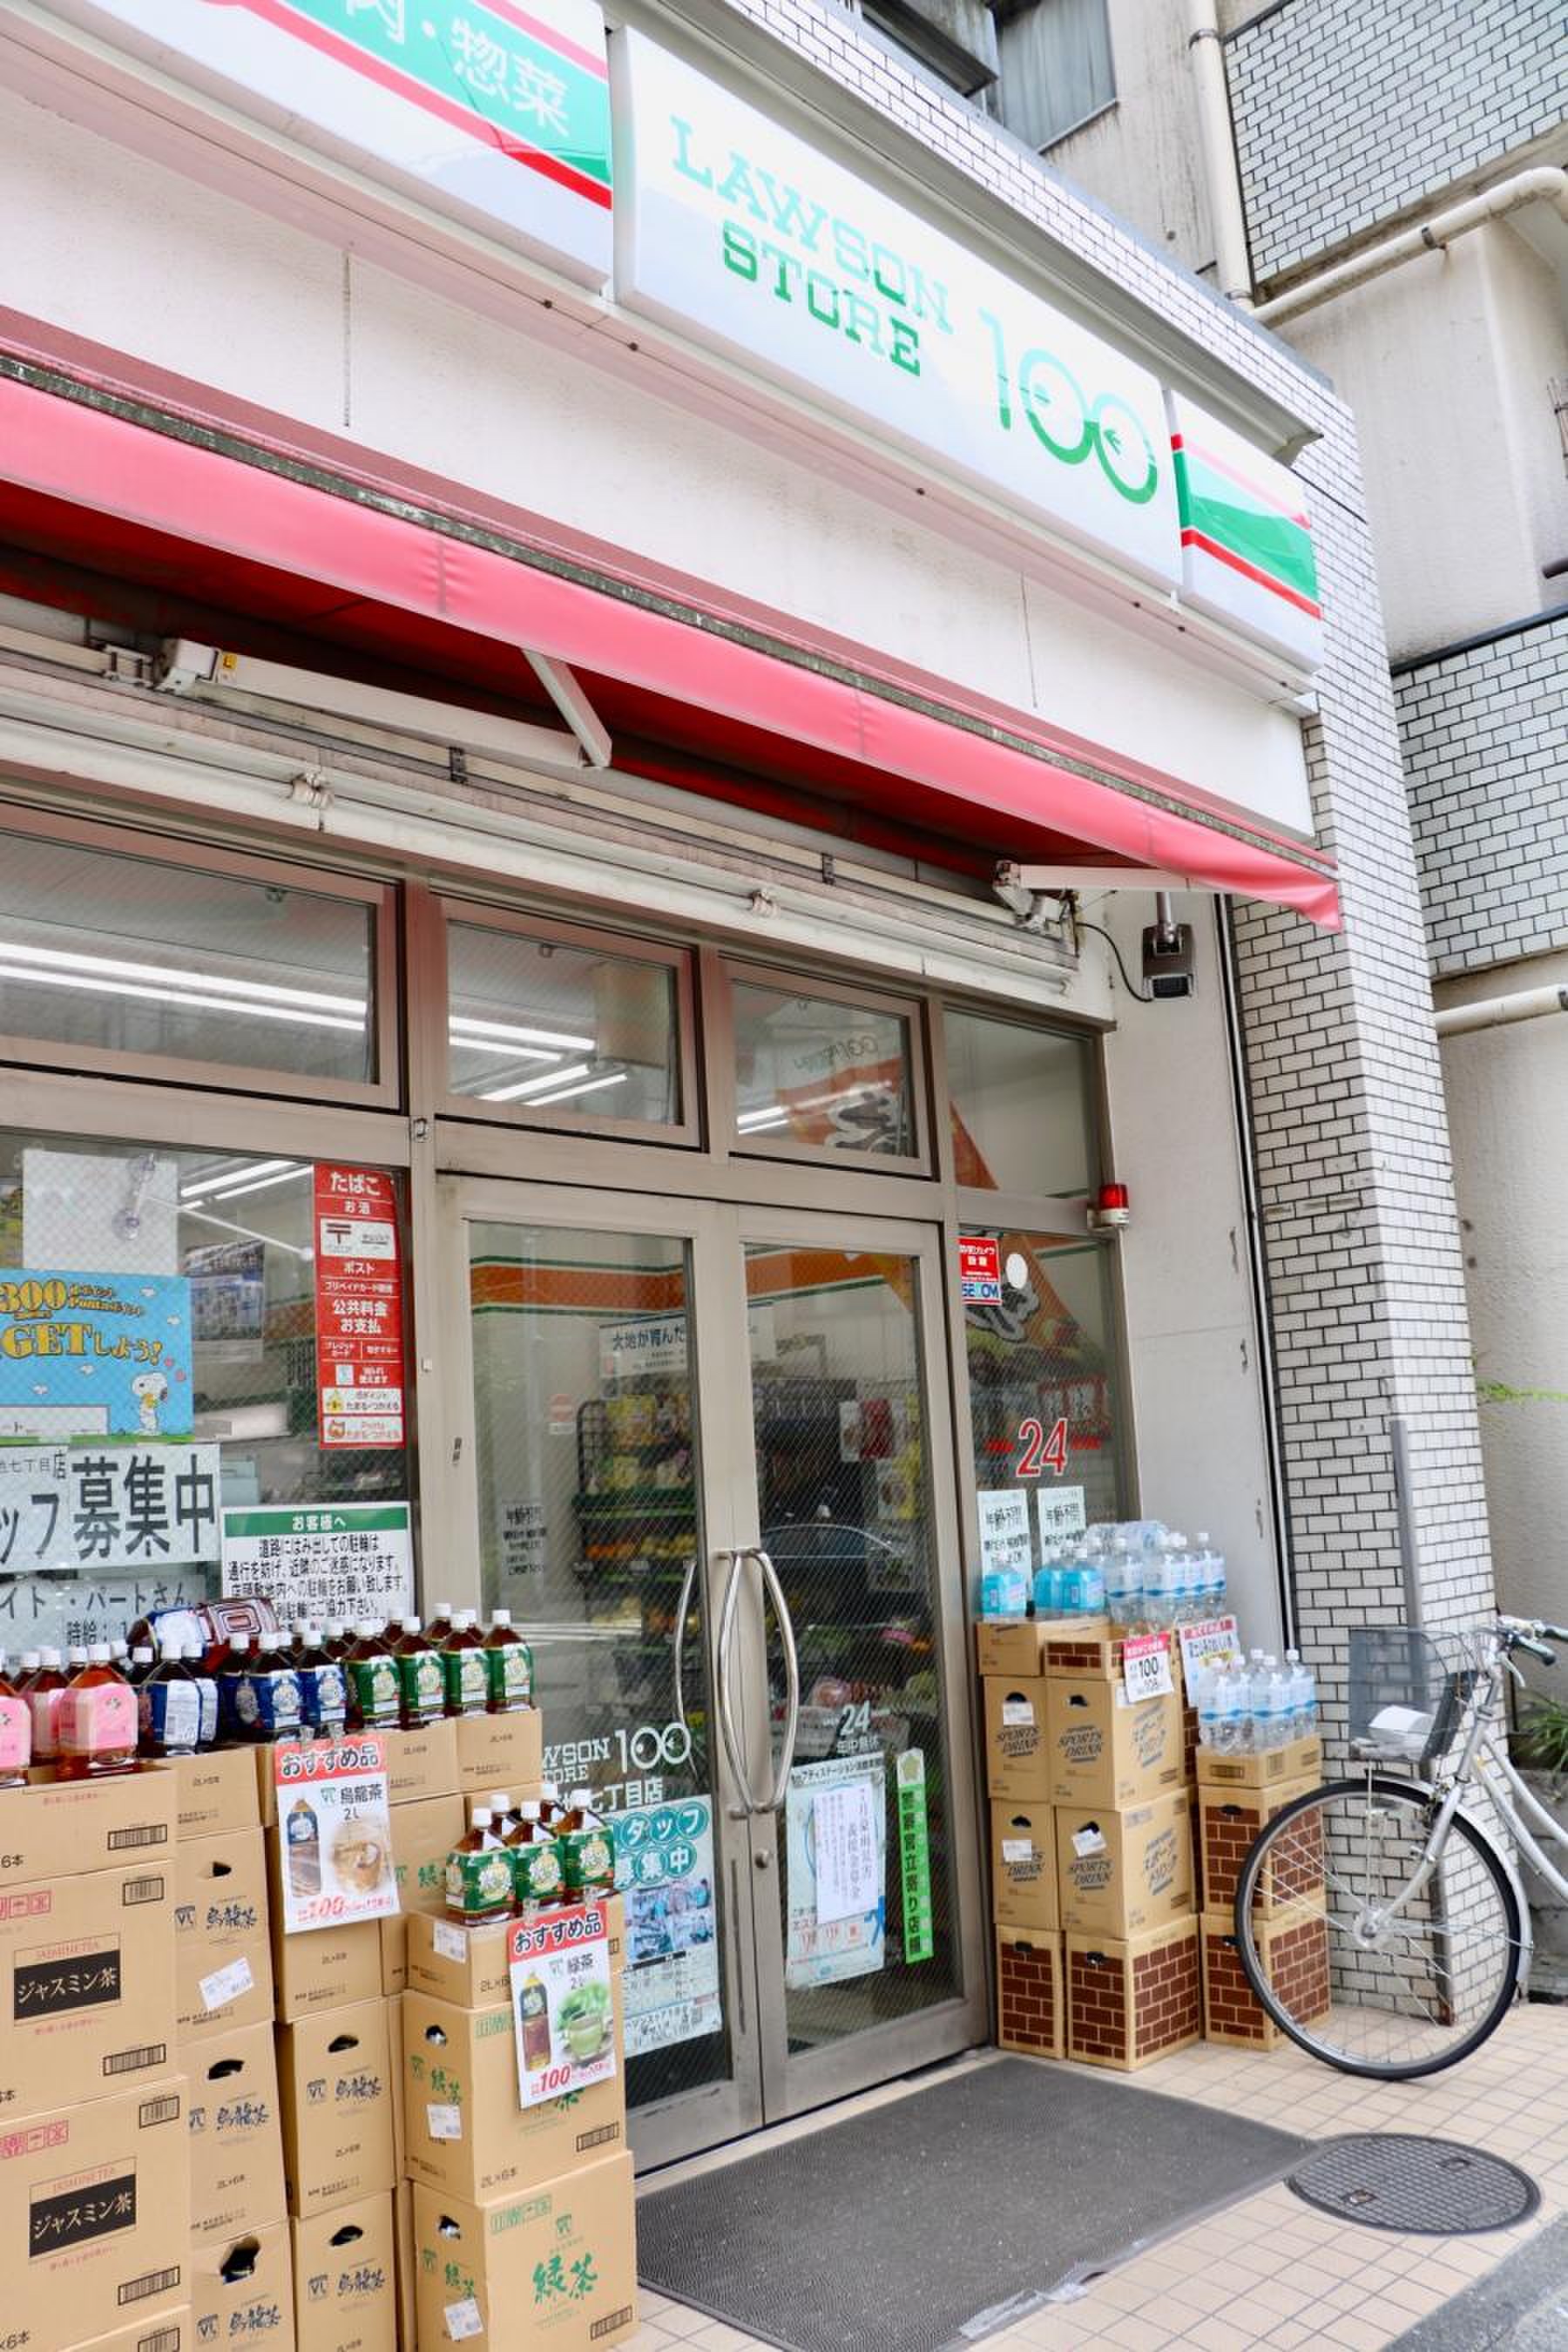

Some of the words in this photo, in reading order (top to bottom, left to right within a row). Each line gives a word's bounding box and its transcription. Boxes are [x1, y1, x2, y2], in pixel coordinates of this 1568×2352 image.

[670, 114, 954, 335] LAWSON
[722, 221, 922, 377] STORE
[979, 306, 1158, 505] 100
[331, 1172, 381, 1196] たばこ
[343, 1260, 375, 1275] ポスト
[962, 1282, 999, 1298] SEOM
[333, 1300, 389, 1317] 公共料金
[341, 1318, 382, 1335] お支払
[1016, 1417, 1068, 1478] 24
[292, 1514, 347, 1531] お客様へ
[1139, 1656, 1159, 1679] 100
[840, 1700, 871, 1736] 24
[281, 1745, 379, 1777] おすすめ品
[544, 1736, 610, 1769] WSON
[614, 1722, 691, 1774] 100
[544, 1764, 589, 1785] TORE
[558, 1777, 664, 1813] 七丁目店
[515, 1912, 602, 1952] おすすめ品
[17, 1966, 118, 2004] ジャスミン茶
[540, 2065, 571, 2092] 100
[33, 2191, 132, 2240] ジャスミン茶
[531, 2252, 598, 2304] 緑茶
